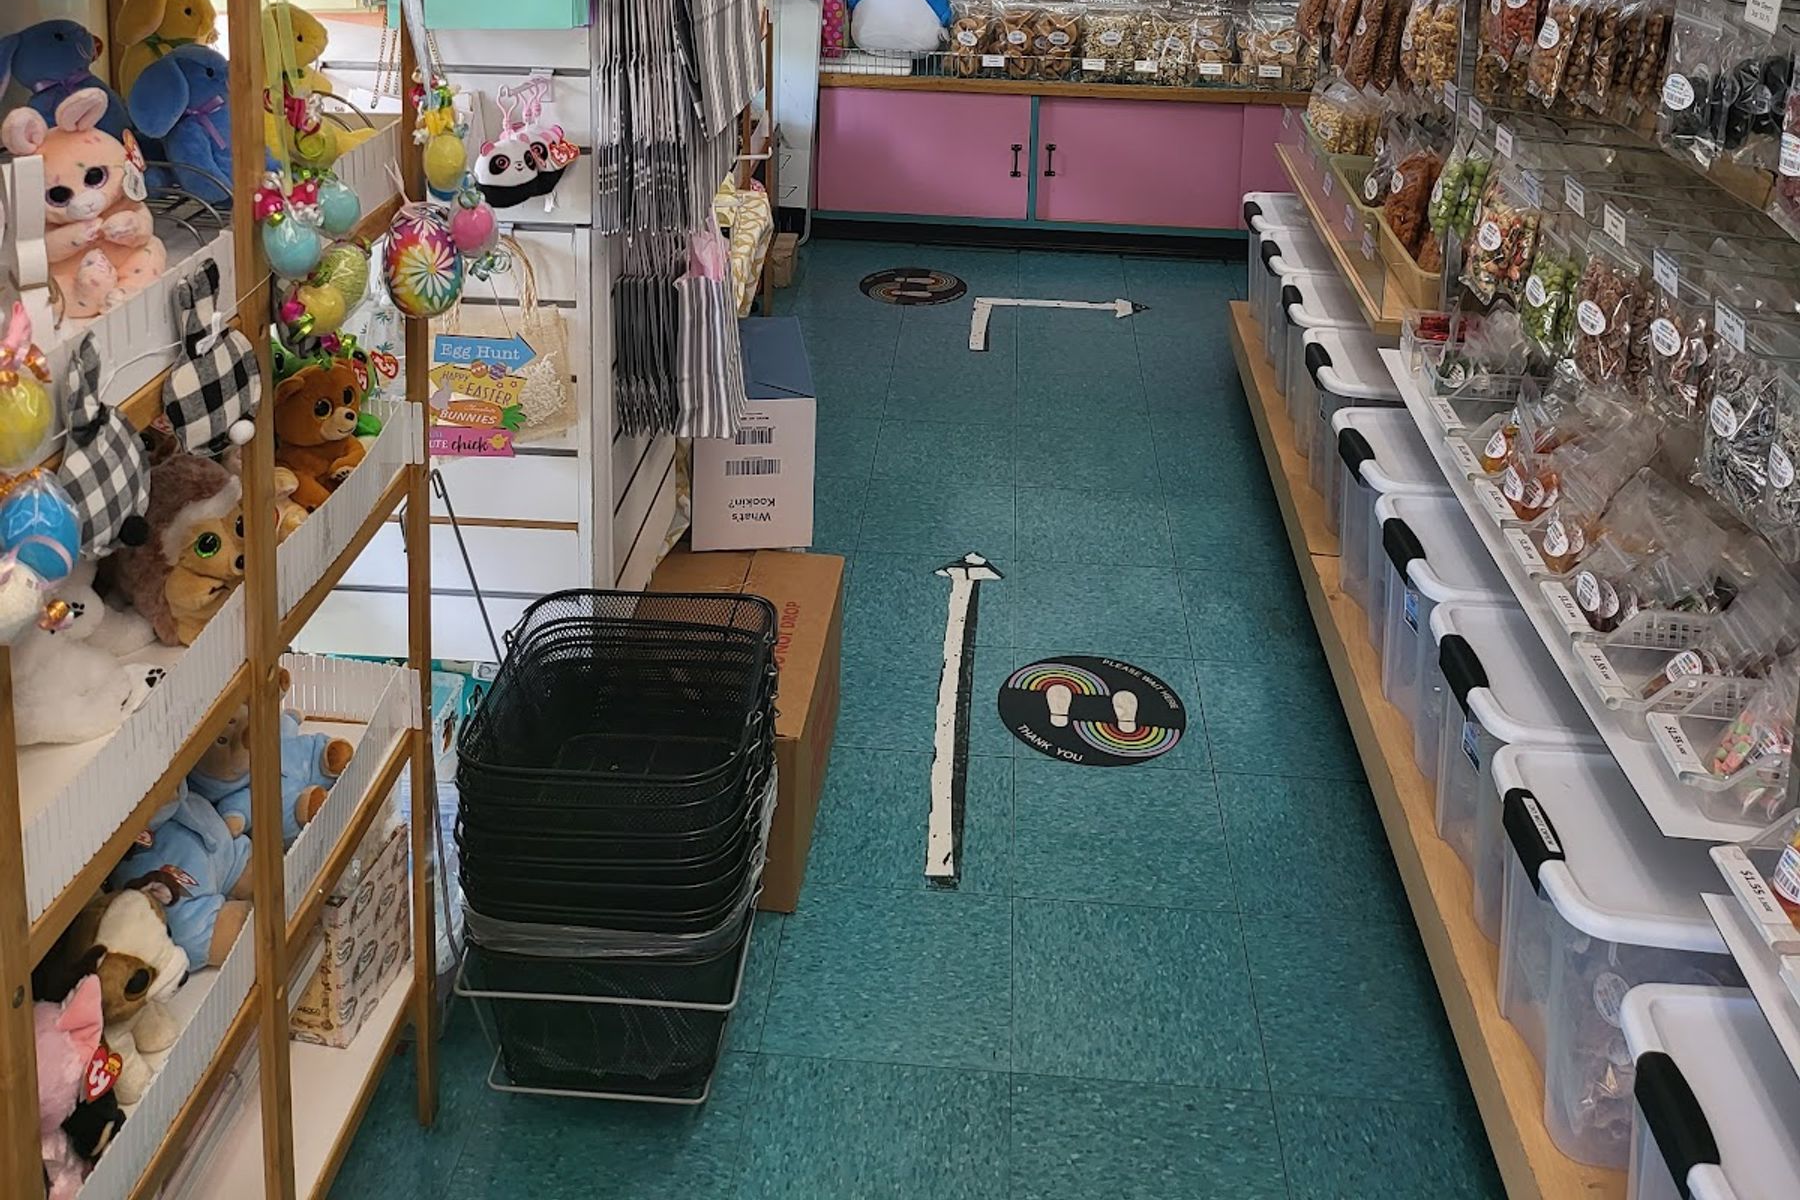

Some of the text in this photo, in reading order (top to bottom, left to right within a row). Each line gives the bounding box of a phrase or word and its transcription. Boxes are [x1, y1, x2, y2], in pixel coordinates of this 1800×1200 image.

[440, 343, 520, 360] Egg Hunt
[442, 370, 470, 382] HAPPY
[465, 382, 512, 404] EASTER
[440, 409, 497, 424] BUNNIES
[429, 439, 448, 448] UTE
[451, 434, 488, 453] chick
[728, 498, 775, 508] Kookin?
[732, 512, 771, 522] What's
[781, 602, 800, 628] DROP
[1102, 659, 1179, 709] PLEASE WAIT HERE
[1017, 723, 1083, 762] THANK YOU
[1740, 870, 1766, 894] $1.55
[89, 1059, 111, 1096] ty
